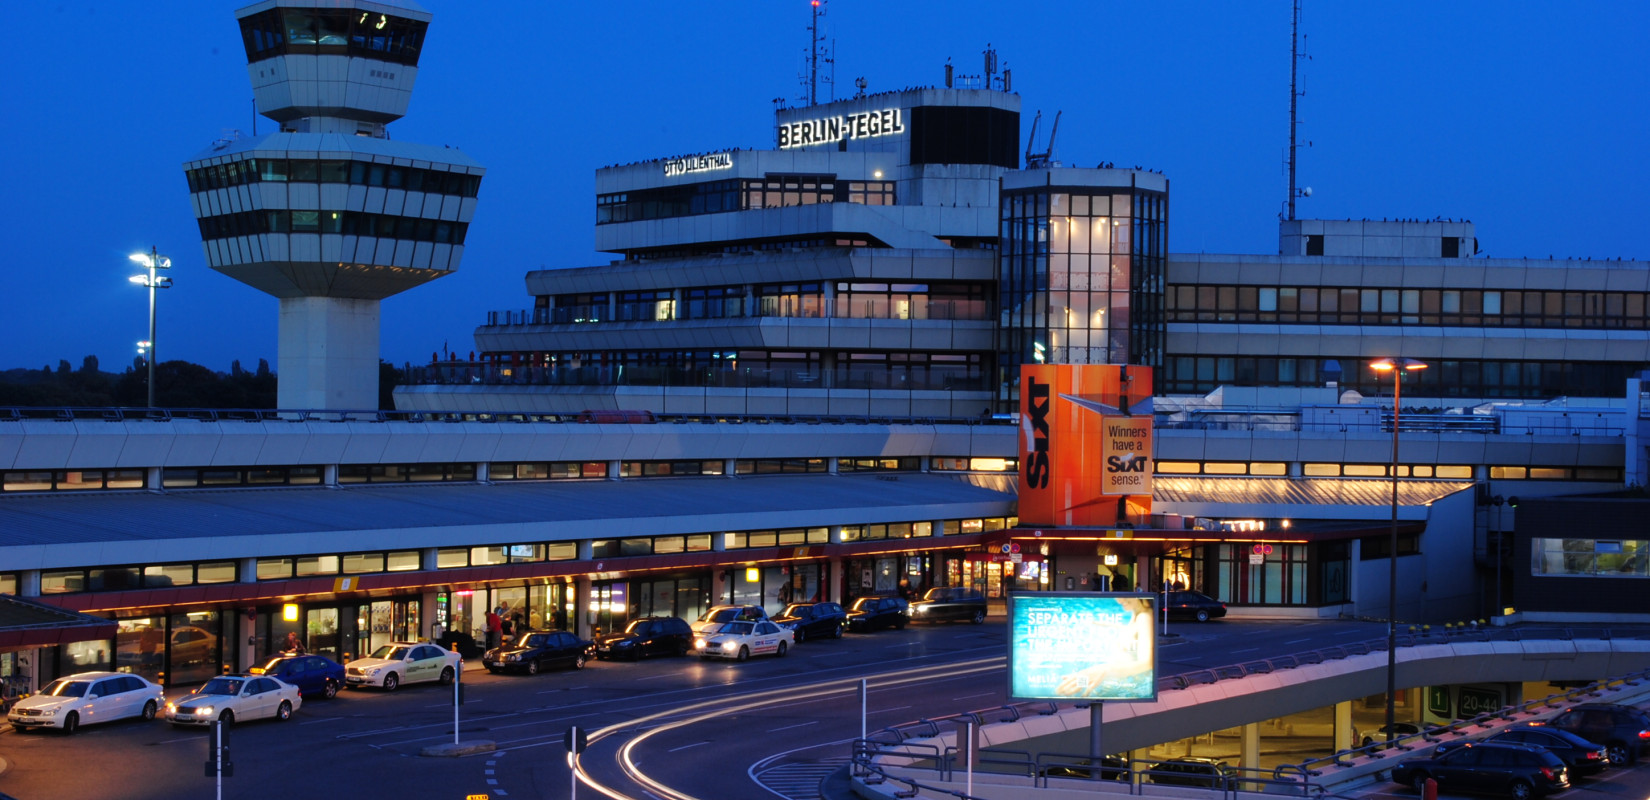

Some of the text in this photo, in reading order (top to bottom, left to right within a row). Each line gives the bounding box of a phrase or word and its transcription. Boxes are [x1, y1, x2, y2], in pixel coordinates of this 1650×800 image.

[779, 108, 905, 149] BERLIN-TEGEL
[664, 154, 732, 176] OTTO LILIENTHAL
[1026, 376, 1050, 490] SIXT
[1108, 425, 1147, 438] Winners
[1112, 439, 1143, 451] have a
[1107, 454, 1148, 473] SIXT
[1028, 612, 1123, 625] SEPARATE THE
[1435, 691, 1498, 711] 1 20-44
